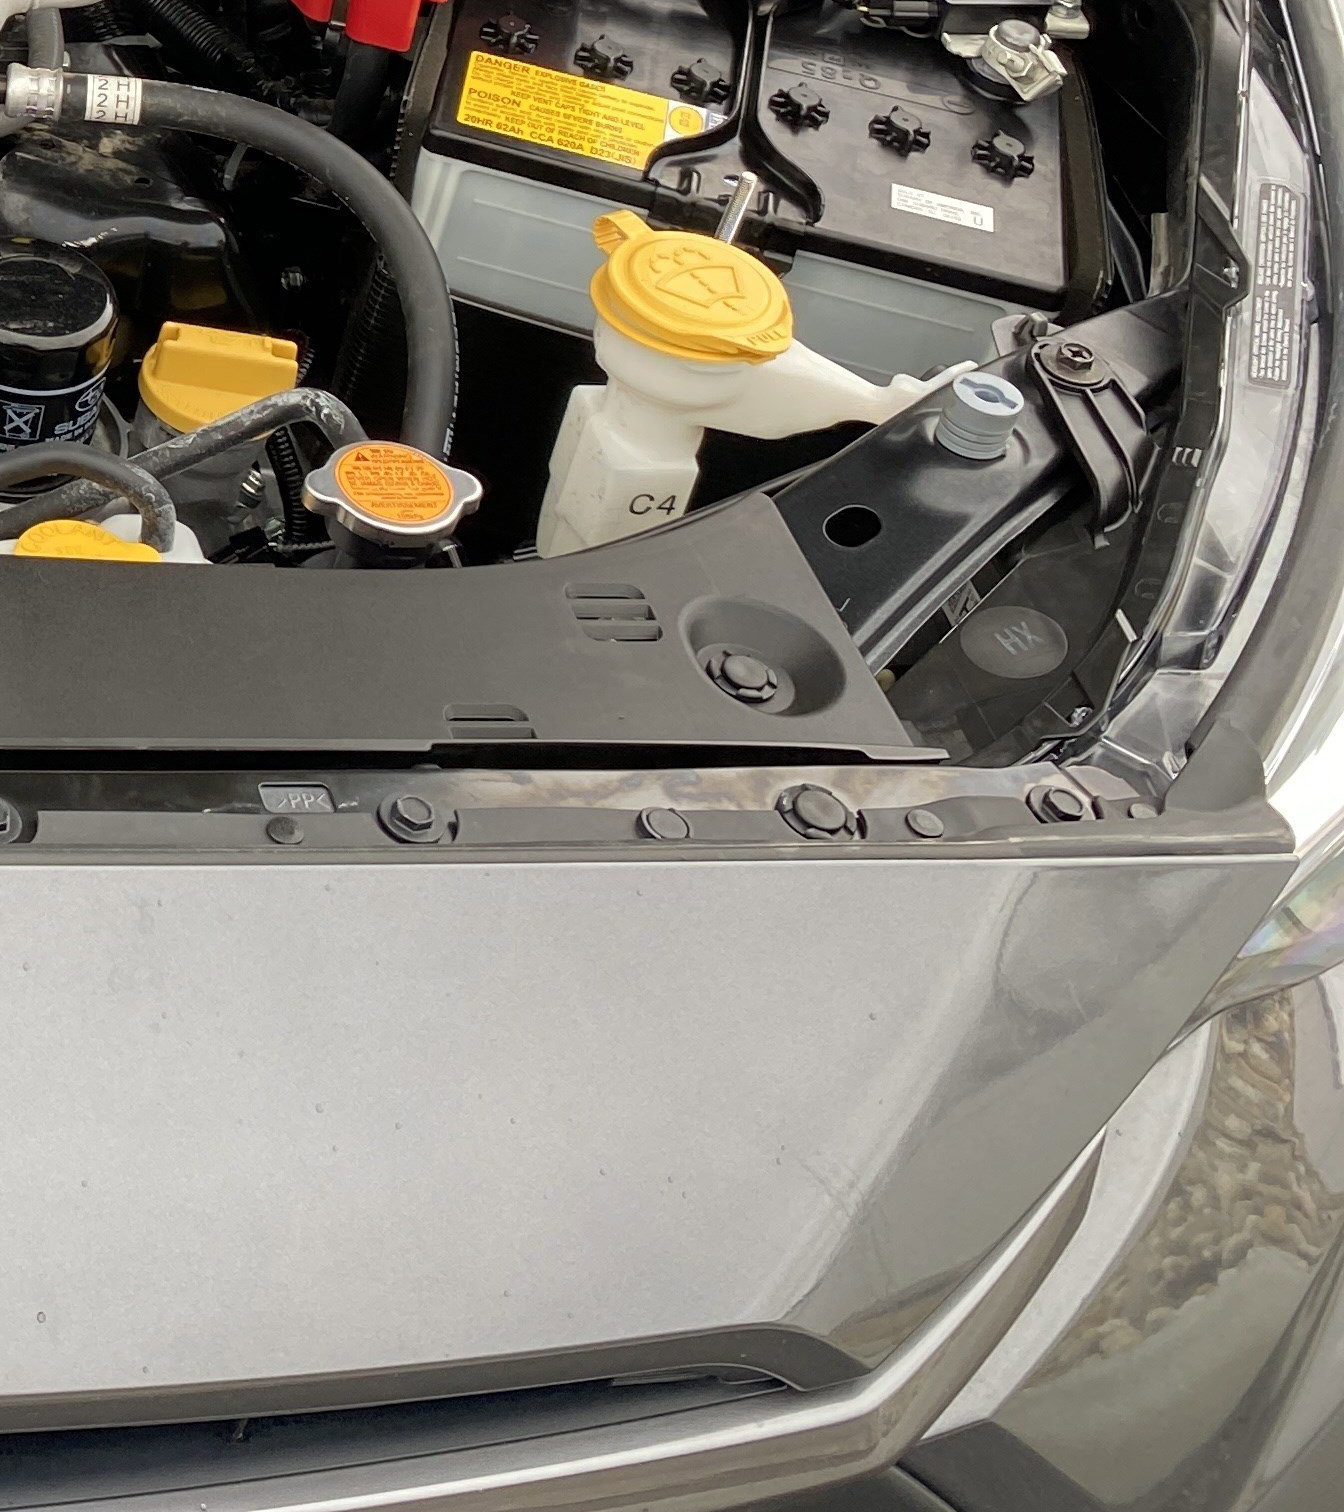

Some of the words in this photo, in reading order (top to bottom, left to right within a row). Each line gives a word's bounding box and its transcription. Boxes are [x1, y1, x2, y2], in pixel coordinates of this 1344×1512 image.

[475, 54, 531, 74] DANGER
[468, 87, 522, 108] POISON
[533, 96, 553, 106] VENT
[464, 114, 493, 129] 20HR
[529, 131, 554, 144] CCA
[746, 330, 787, 346] PULL
[629, 493, 676, 515] C4
